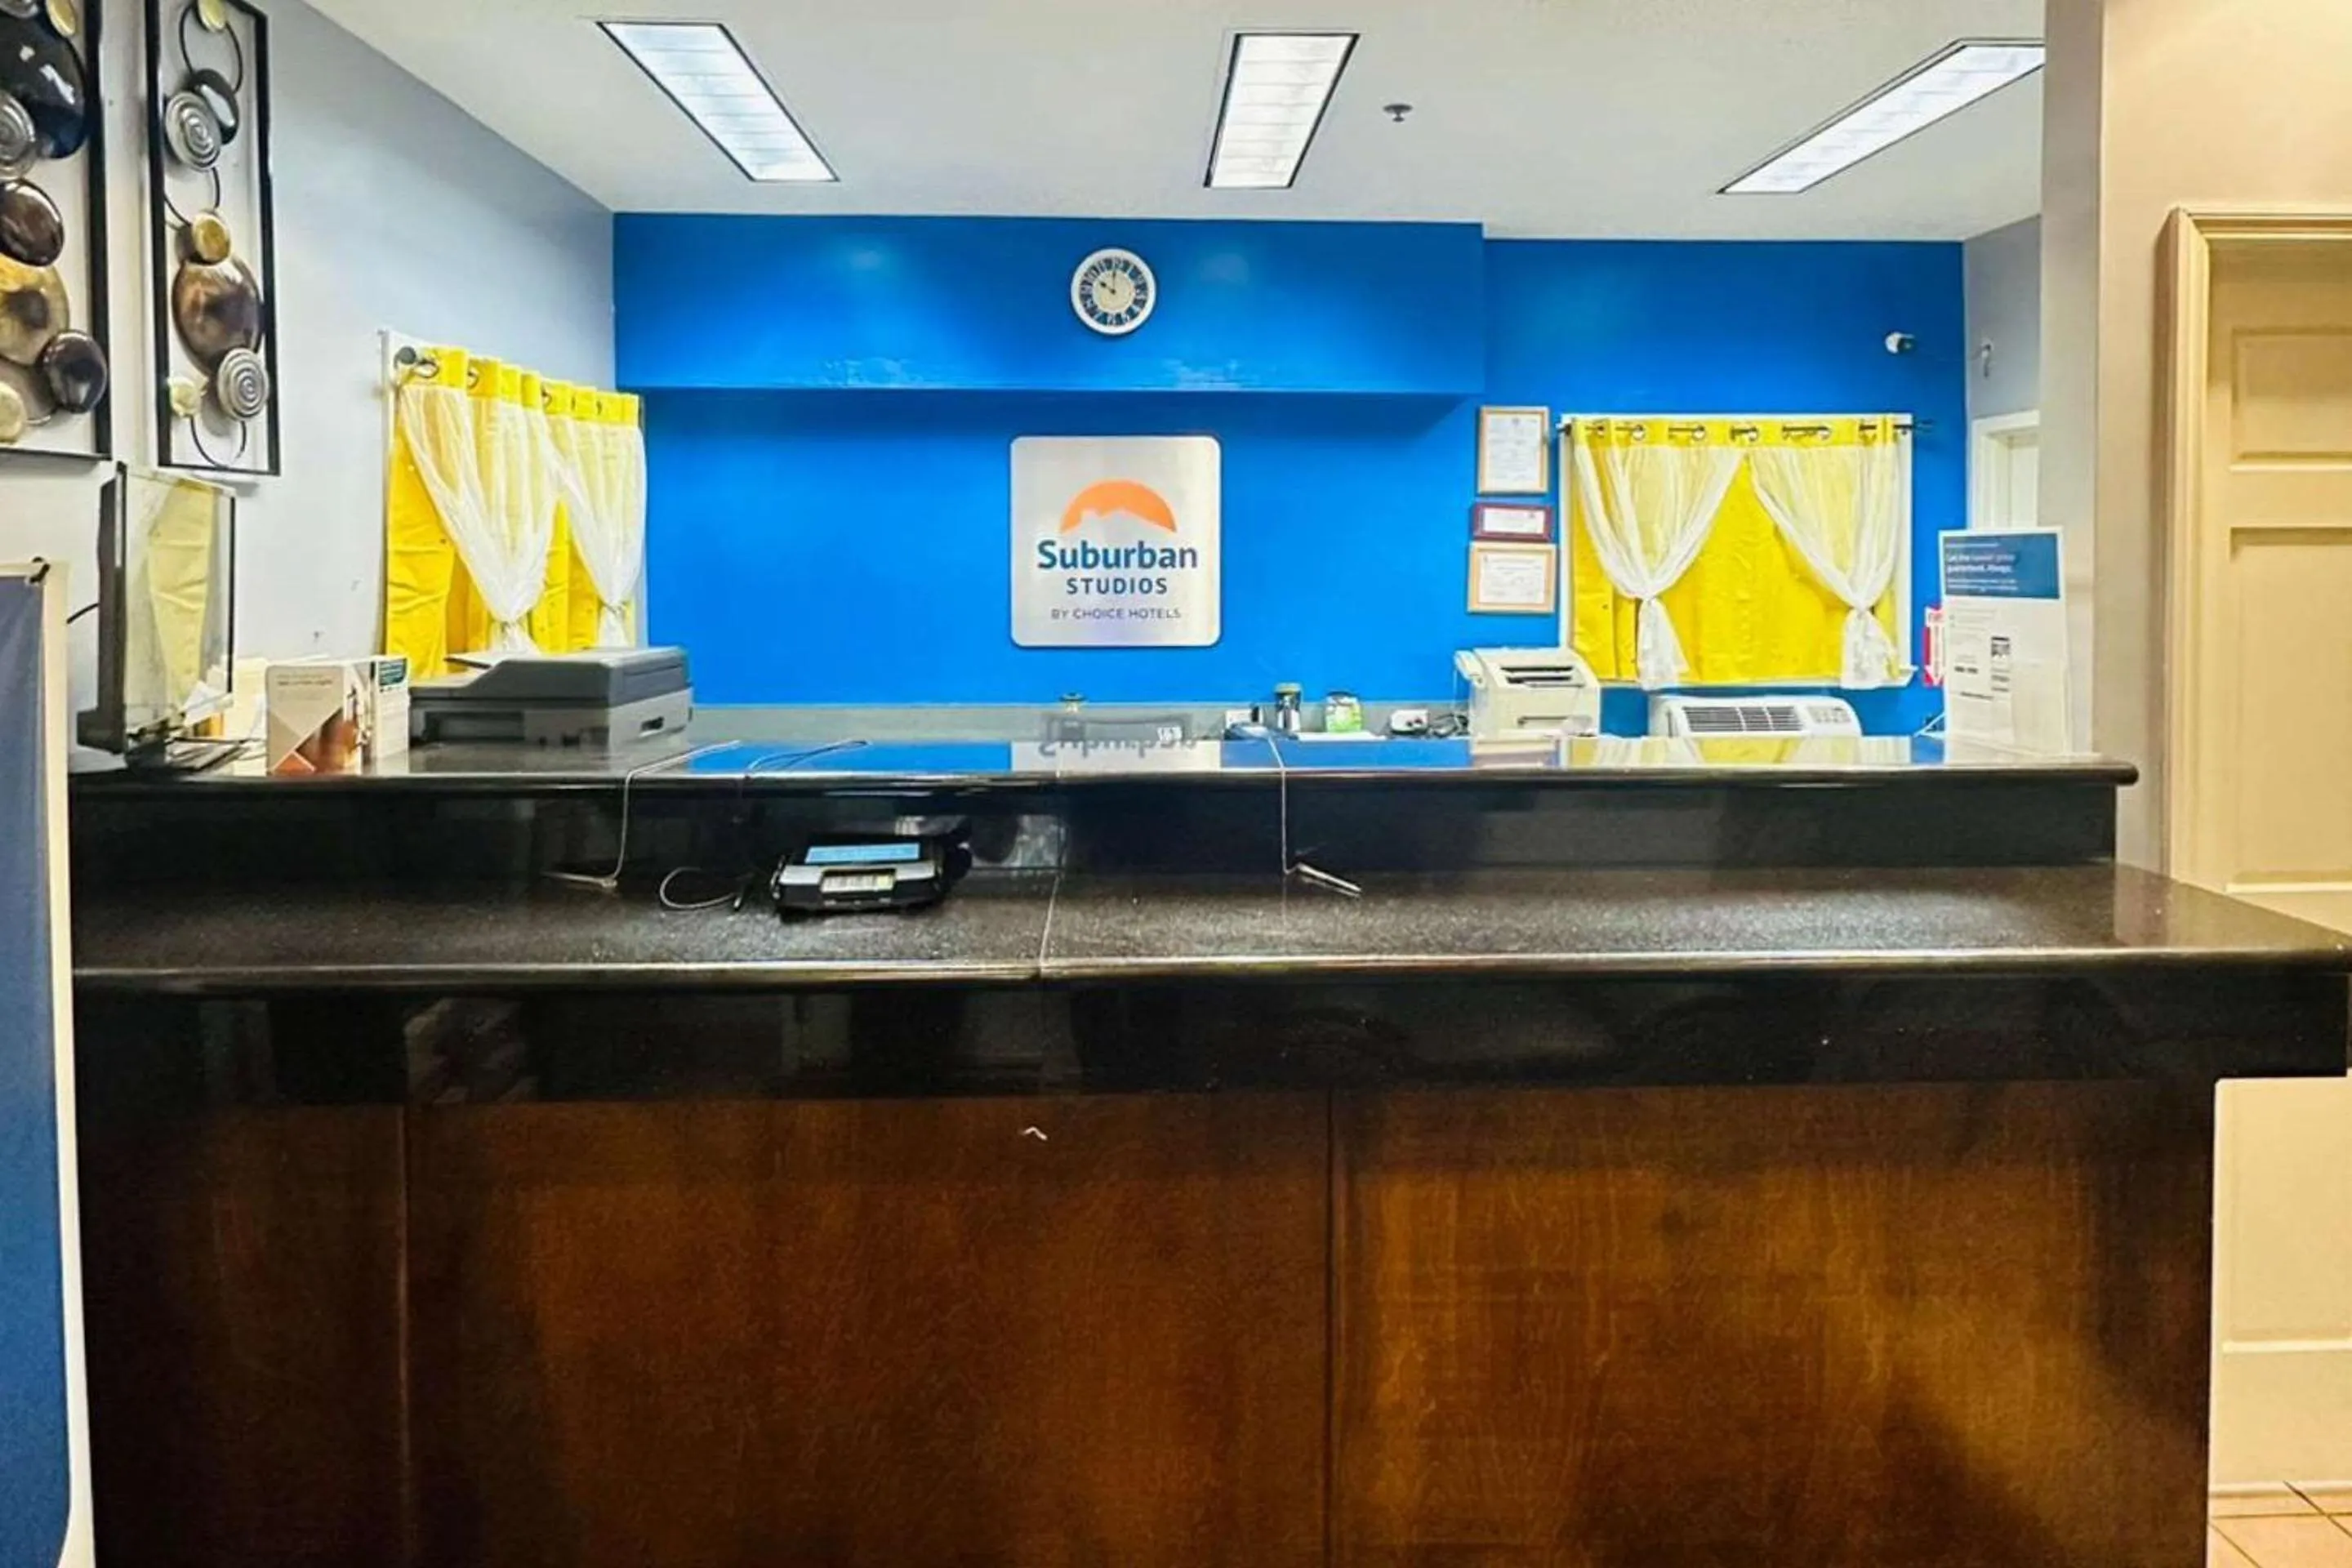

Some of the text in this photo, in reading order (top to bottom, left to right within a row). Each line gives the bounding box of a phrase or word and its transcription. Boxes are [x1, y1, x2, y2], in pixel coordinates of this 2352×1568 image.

[1036, 539, 1197, 569] Suburban
[1067, 577, 1168, 595] STUDIOS
[1051, 608, 1181, 620] BY CHOICE HOTELS
